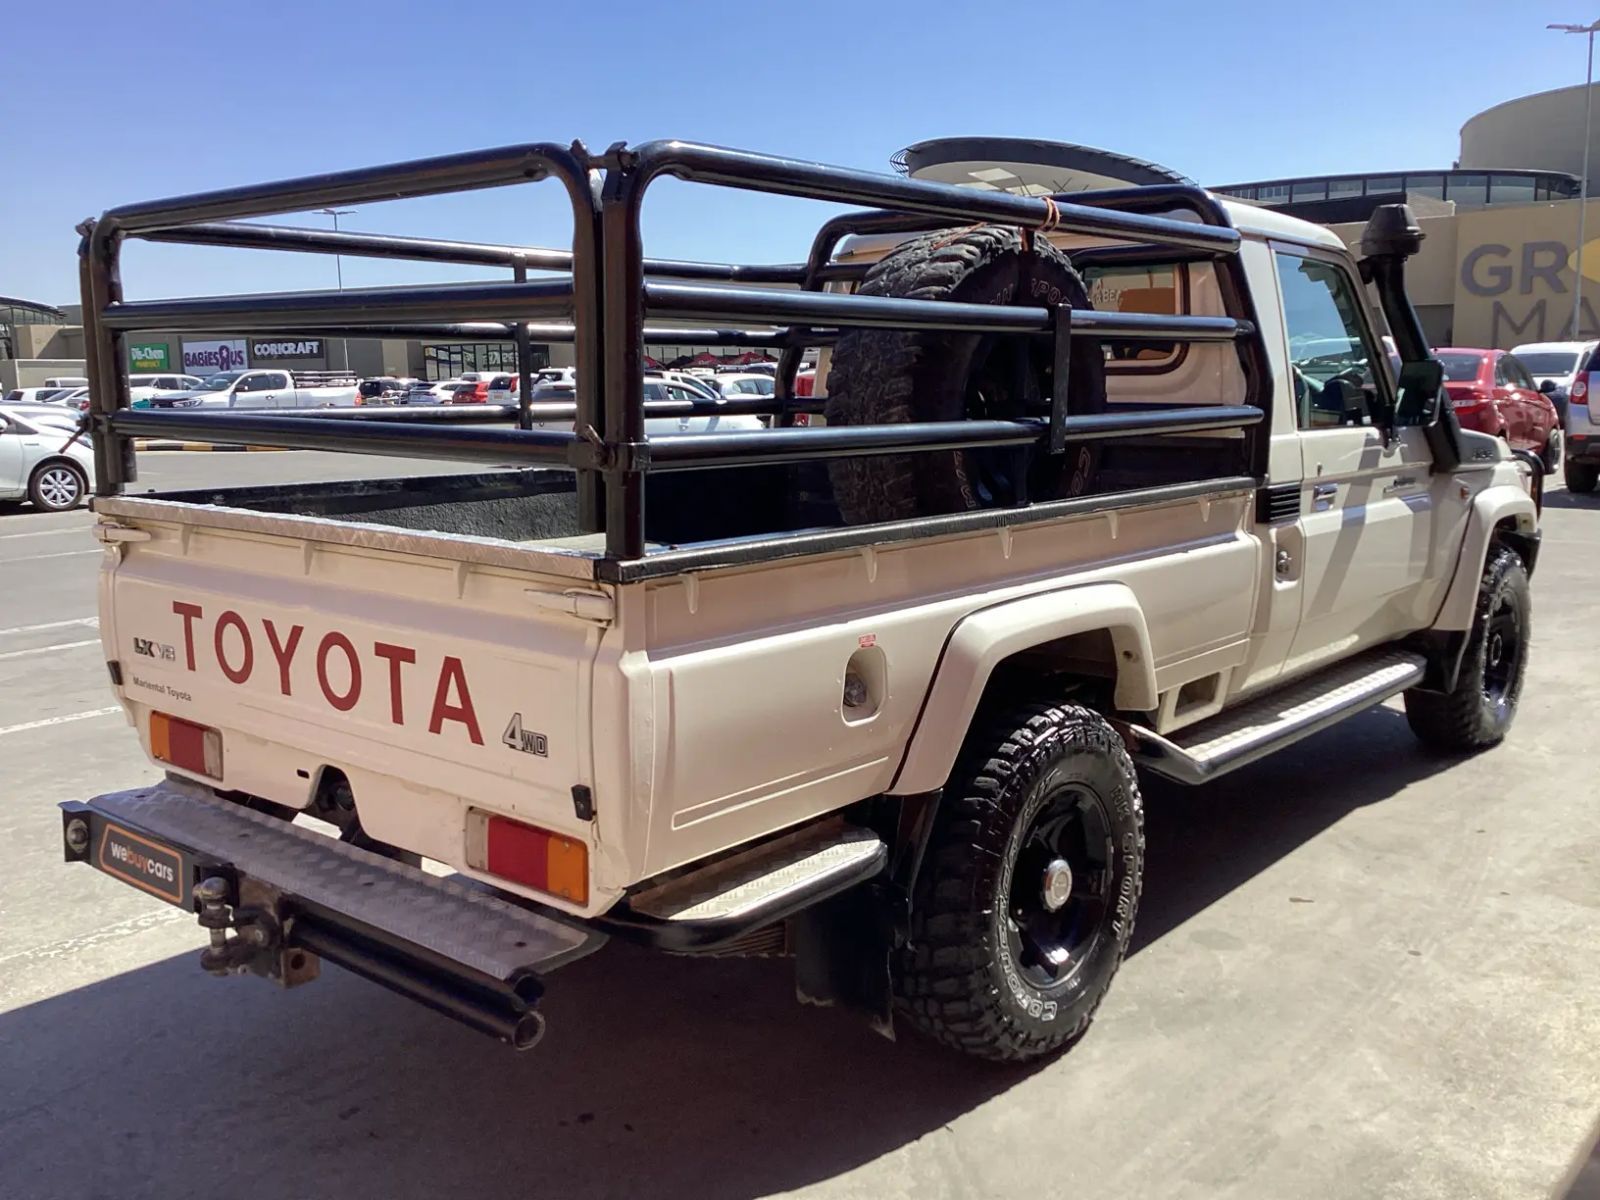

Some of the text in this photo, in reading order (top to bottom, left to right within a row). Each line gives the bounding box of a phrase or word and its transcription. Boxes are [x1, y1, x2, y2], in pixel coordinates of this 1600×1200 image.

[231, 350, 244, 366] US
[254, 342, 319, 355] CORICRAFT
[132, 676, 192, 702] Mariental Toyota
[172, 600, 485, 746] TOYOTA
[502, 712, 548, 758] 4WD
[110, 841, 174, 883] webuycars
